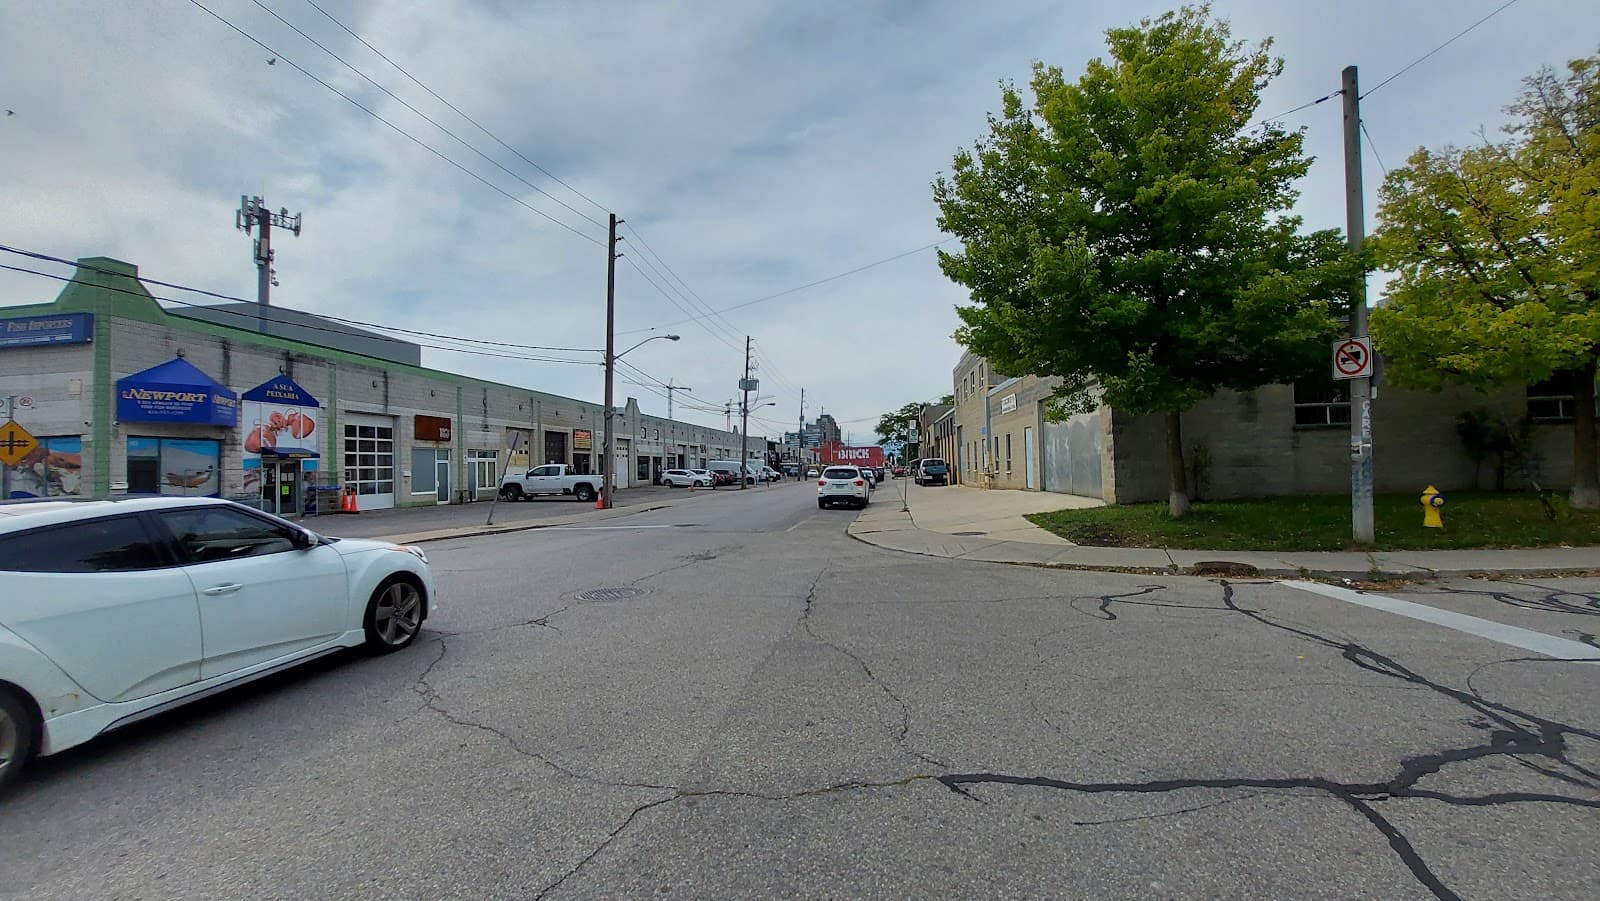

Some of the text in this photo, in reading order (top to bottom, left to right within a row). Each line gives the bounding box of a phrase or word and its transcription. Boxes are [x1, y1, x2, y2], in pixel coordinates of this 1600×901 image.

[279, 383, 294, 392] SUA
[130, 388, 207, 402] NEWPORT
[266, 390, 300, 401] PEIXARIA
